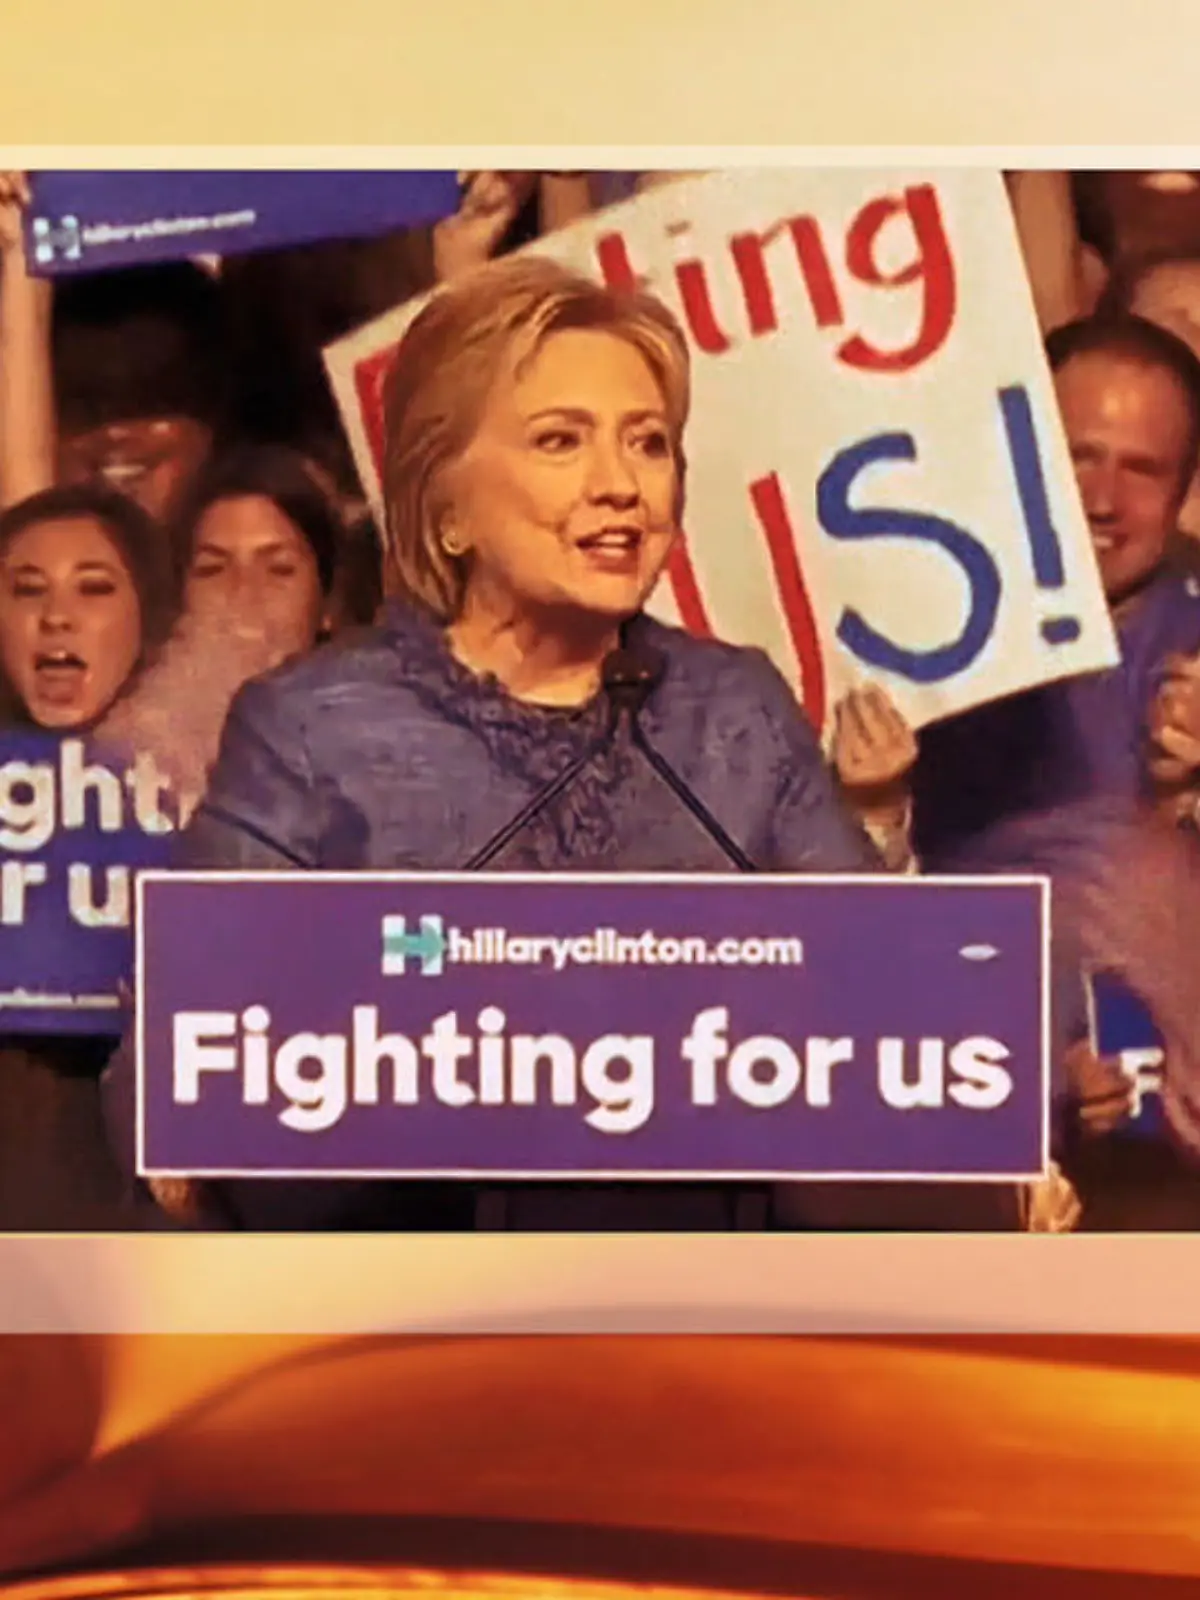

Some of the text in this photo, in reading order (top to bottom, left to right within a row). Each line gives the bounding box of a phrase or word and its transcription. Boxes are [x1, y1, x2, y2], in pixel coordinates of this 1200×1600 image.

[448, 927, 804, 970] hillaryclinton.com
[172, 1004, 1014, 1133] Fighting for us
